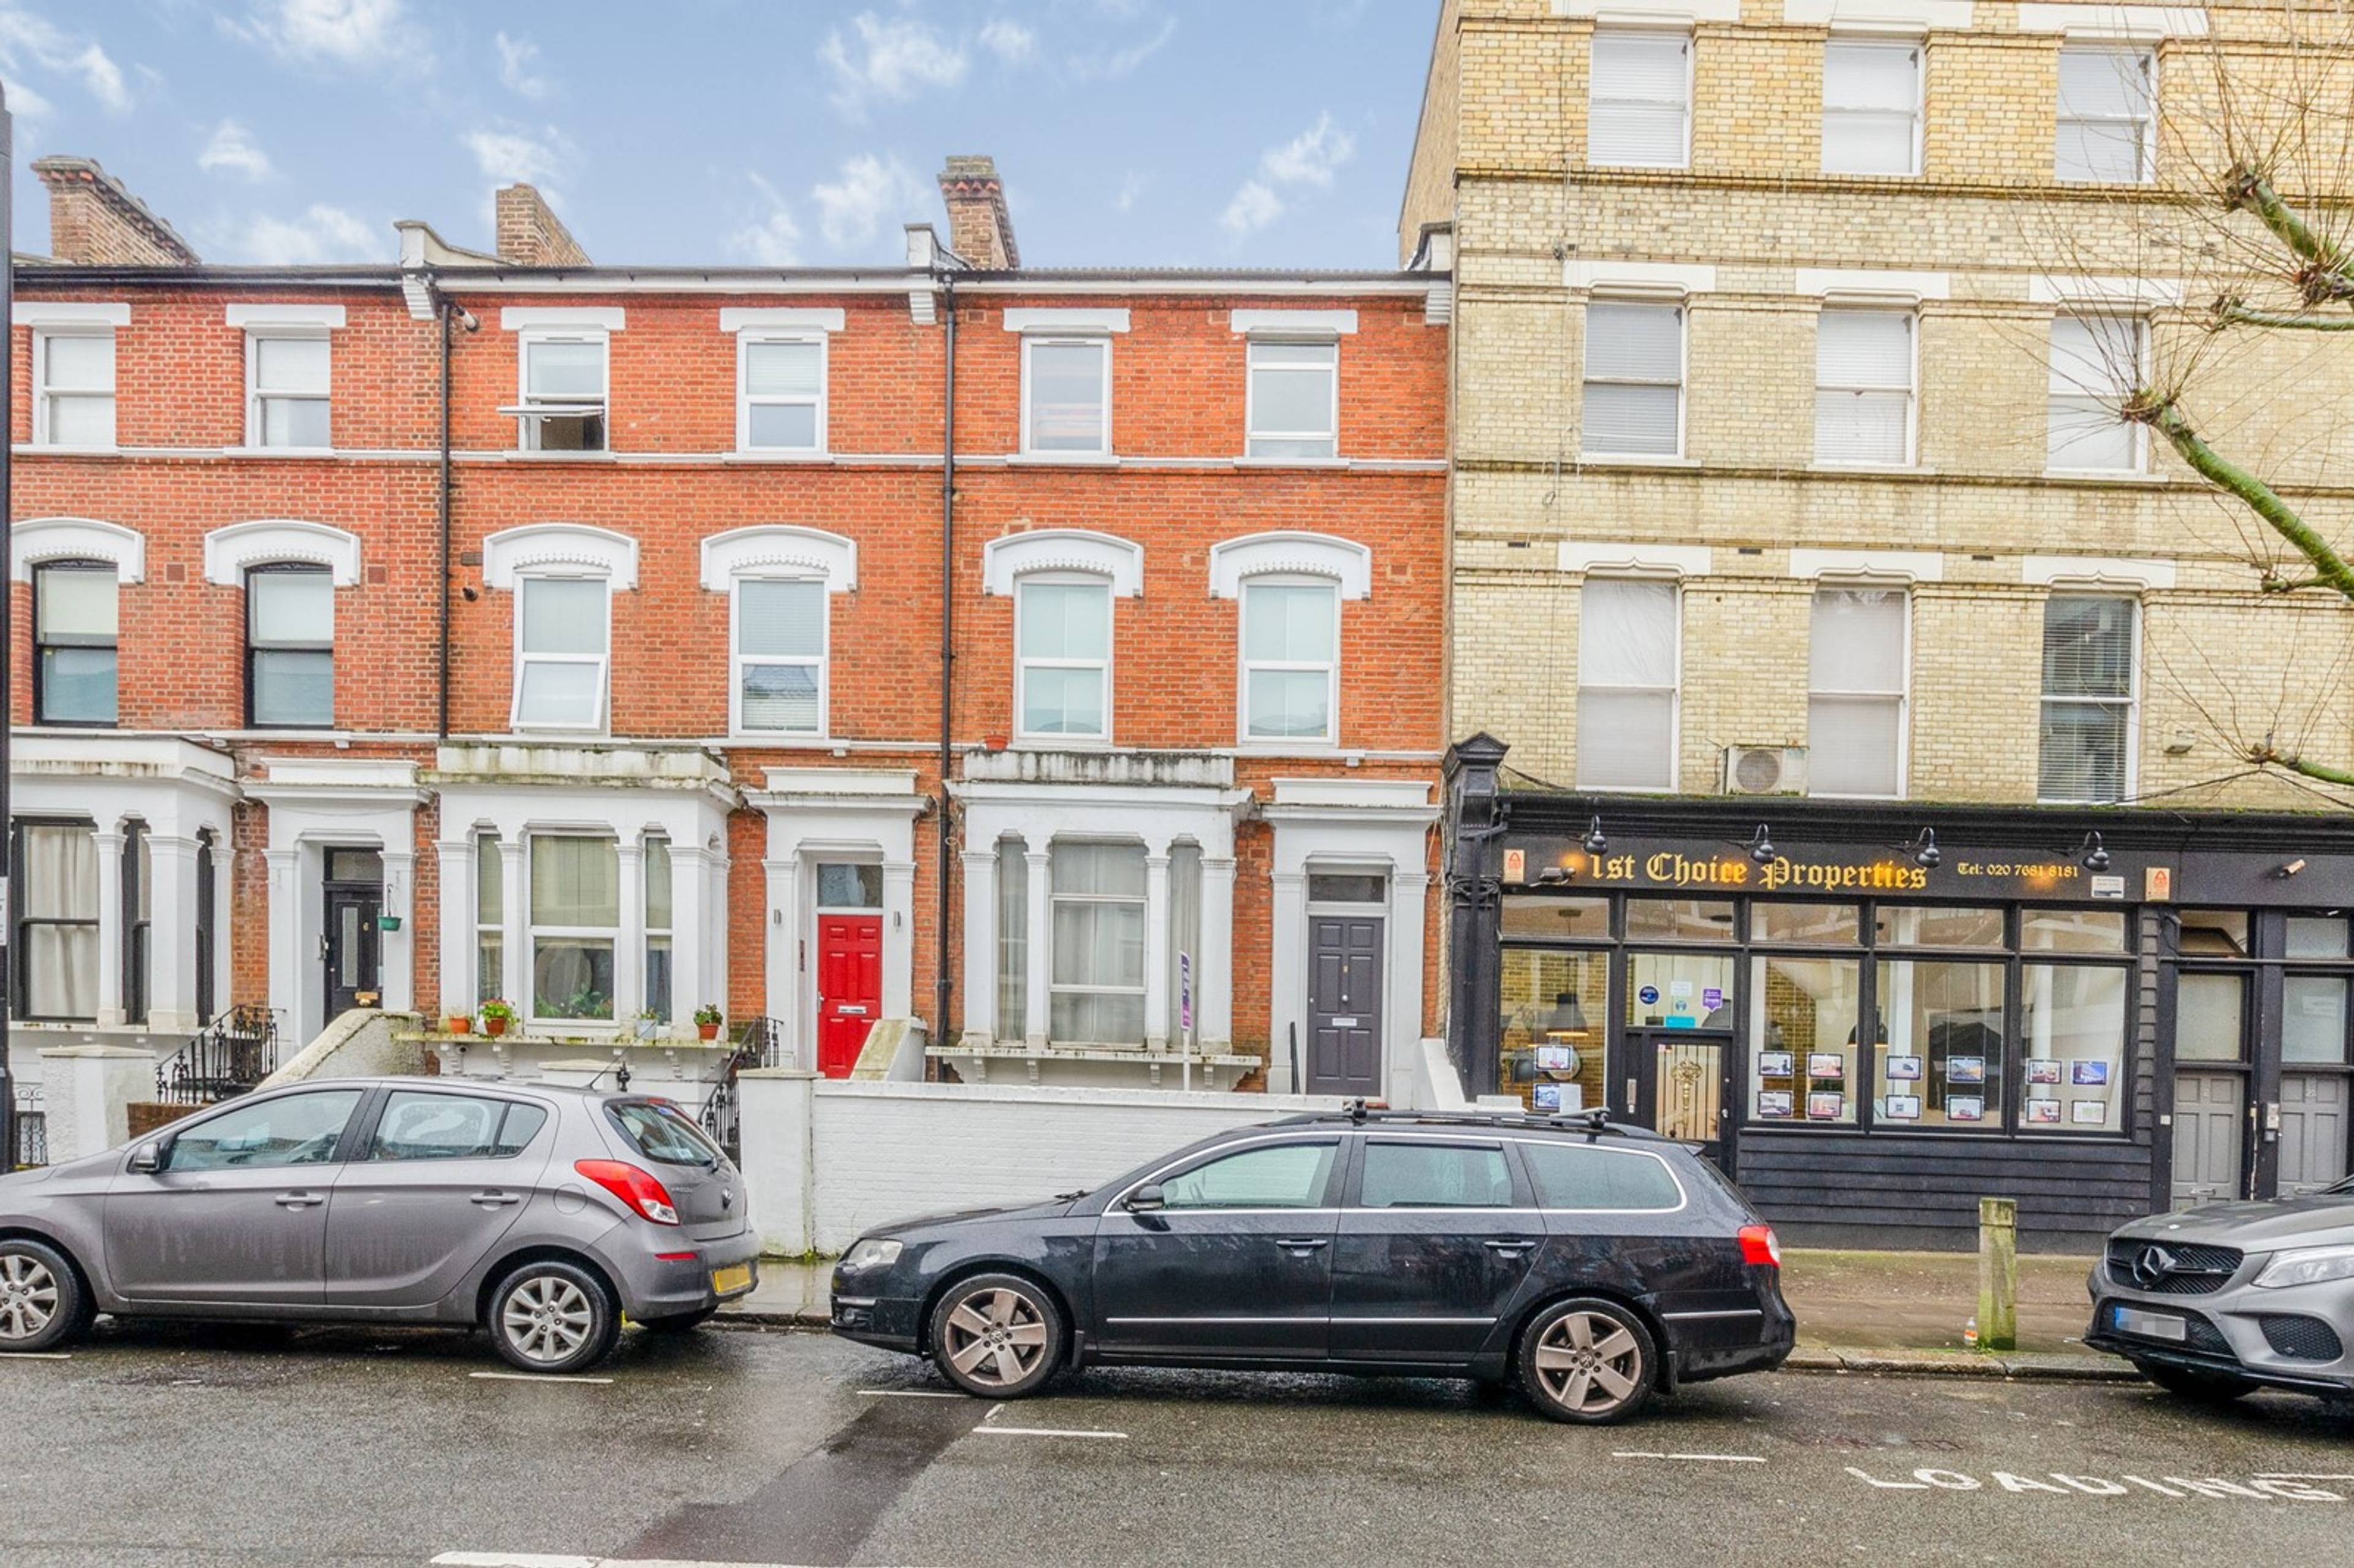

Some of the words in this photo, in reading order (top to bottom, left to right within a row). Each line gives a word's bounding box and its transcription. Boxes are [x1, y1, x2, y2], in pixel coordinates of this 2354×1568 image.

[1590, 854, 1636, 880] 1st
[1647, 852, 1748, 886] Choice
[1758, 856, 1927, 890] Properties
[1957, 862, 1984, 875] Tel:
[1987, 864, 2011, 875] 020
[2014, 864, 2043, 877] 7681
[2049, 865, 2079, 878] 8181
[1845, 1466, 2349, 1501] LOADING
